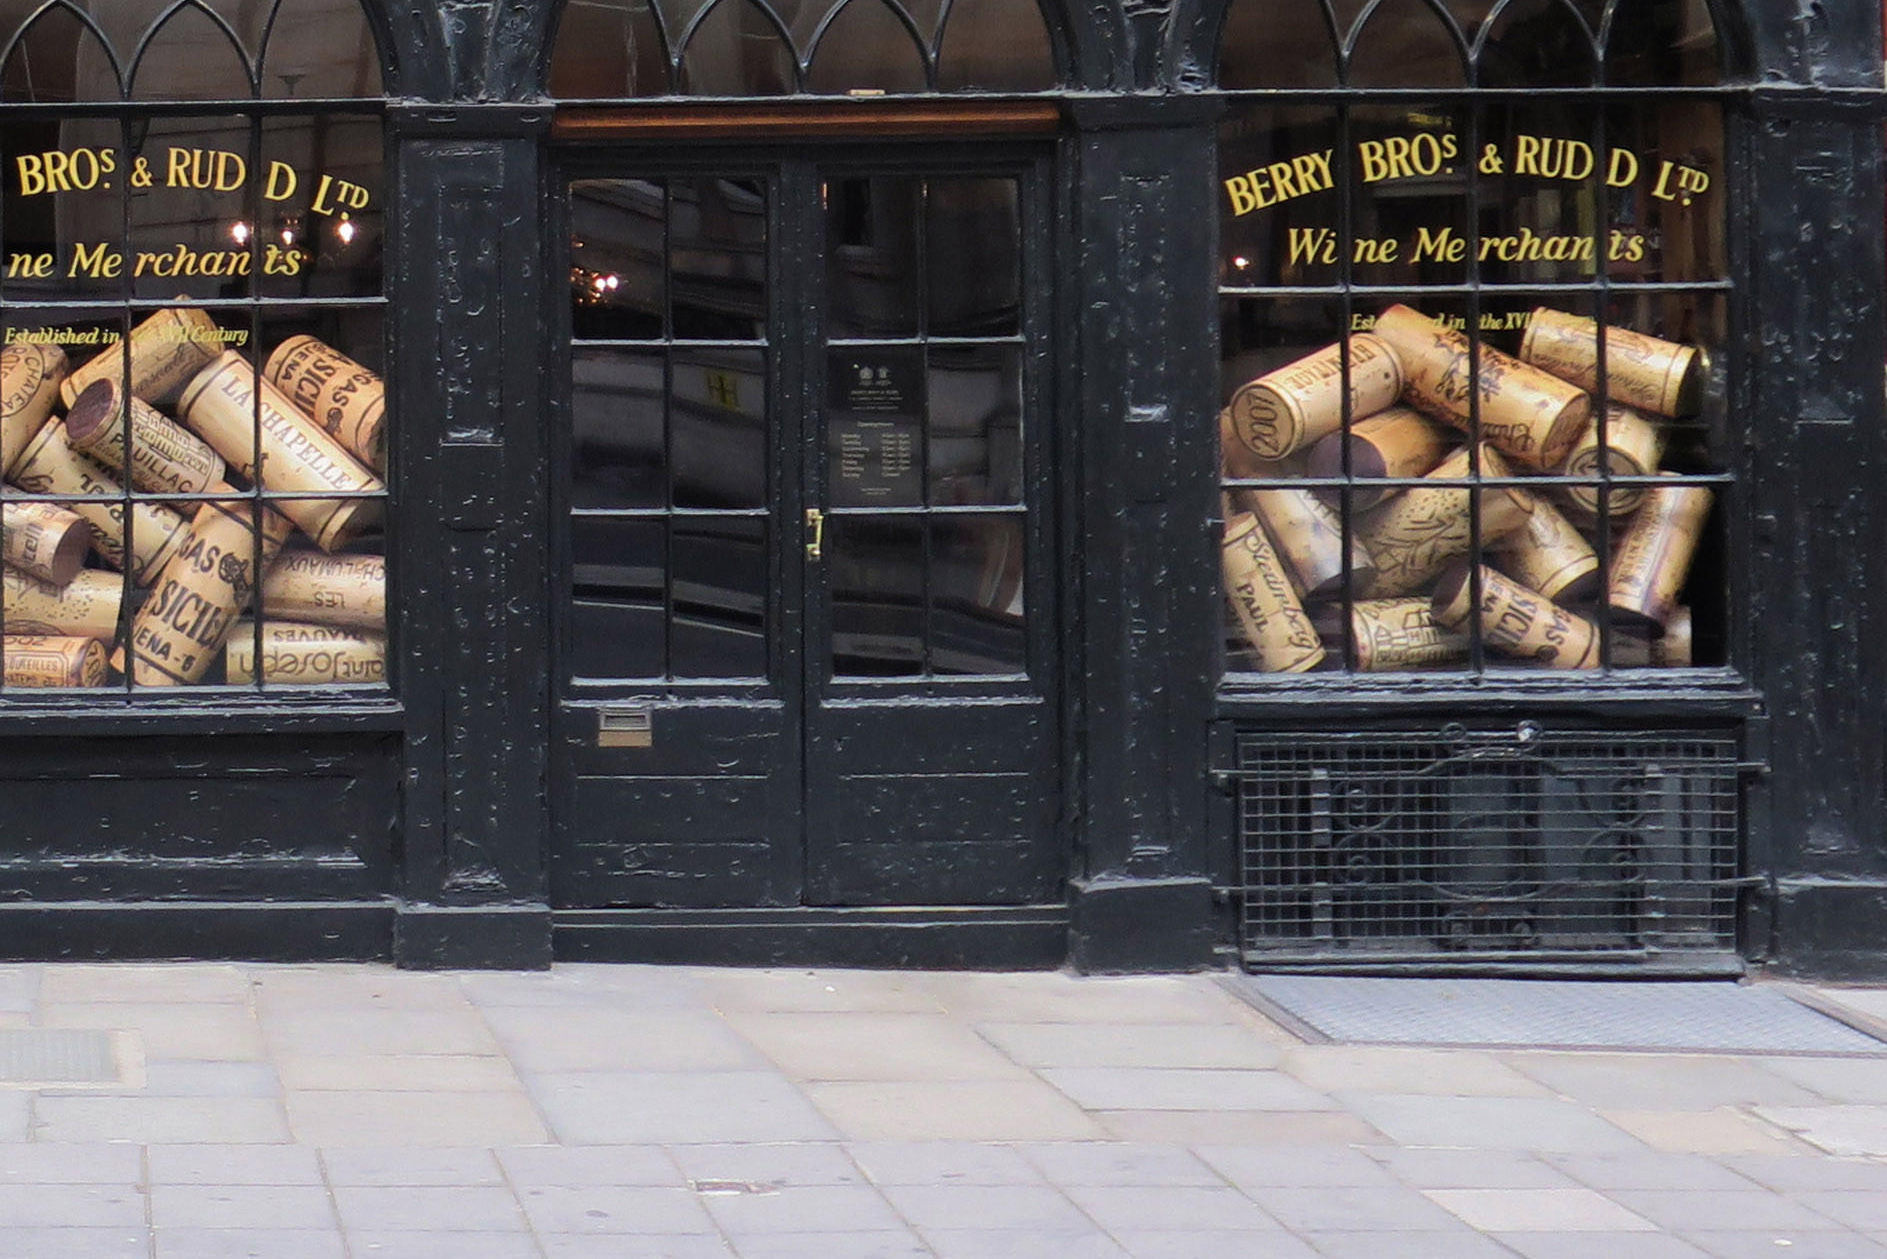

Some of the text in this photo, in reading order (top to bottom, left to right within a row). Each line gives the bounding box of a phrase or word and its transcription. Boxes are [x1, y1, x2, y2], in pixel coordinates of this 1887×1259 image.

[131, 157, 153, 187] &
[167, 147, 297, 201] RUDD
[1225, 150, 1334, 216] BERRY
[1480, 143, 1503, 173] &
[1516, 135, 1638, 187] RUDD
[68, 243, 301, 277] Merchants
[1289, 228, 1645, 265] Wine Merchants
[4, 327, 99, 345] Established
[101, 328, 120, 344] in
[1479, 313, 1503, 330] the
[221, 375, 253, 408] LA
[259, 400, 354, 490] CHAPELLE
[1235, 584, 1271, 632] PAUL
